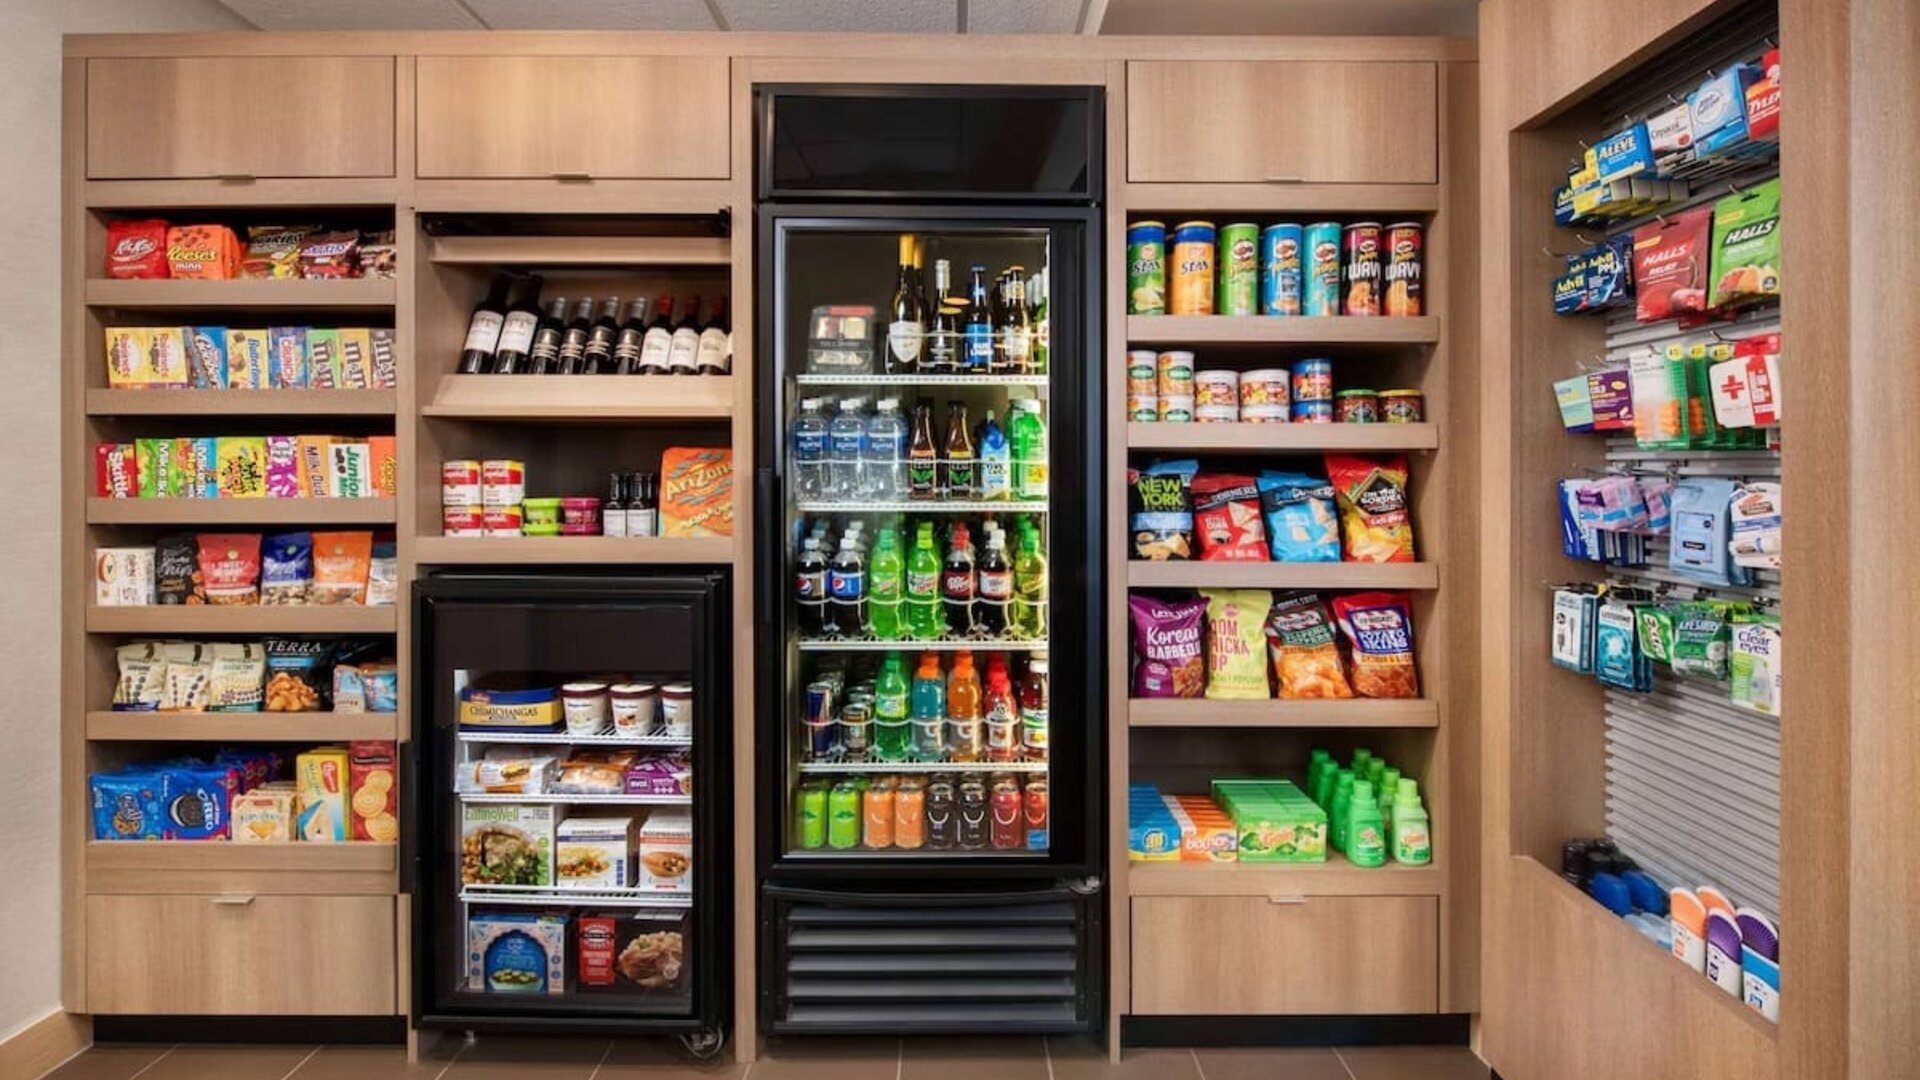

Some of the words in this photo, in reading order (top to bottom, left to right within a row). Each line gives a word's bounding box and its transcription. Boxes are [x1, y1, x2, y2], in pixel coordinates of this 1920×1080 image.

[1600, 135, 1635, 159] ALEVE
[1726, 220, 1776, 245] HALLS
[1643, 244, 1688, 266] HALLS
[175, 261, 202, 271] minis
[1557, 274, 1584, 294] Advil
[1138, 478, 1181, 493] NEW
[1142, 492, 1183, 507] YORK
[266, 640, 321, 653] TERRA
[1738, 630, 1772, 648] Clear
[1739, 642, 1769, 656] eyes
[197, 788, 214, 831] OREO
